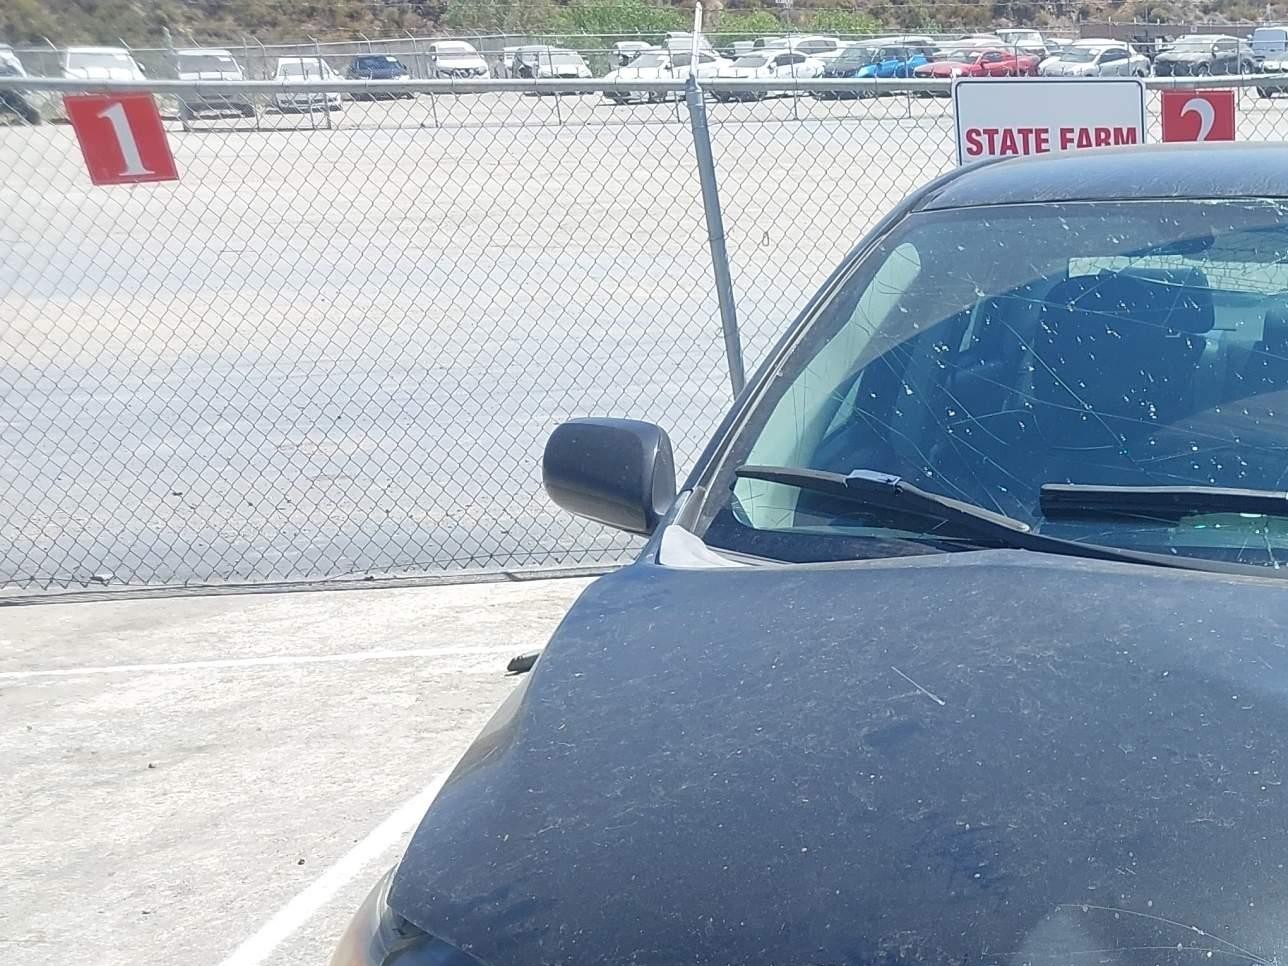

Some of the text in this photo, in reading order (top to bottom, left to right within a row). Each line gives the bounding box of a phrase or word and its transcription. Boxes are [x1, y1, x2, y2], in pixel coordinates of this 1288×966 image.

[96, 102, 155, 176] 1
[1180, 98, 1215, 141] 2
[966, 127, 1137, 156] STATE FARM
